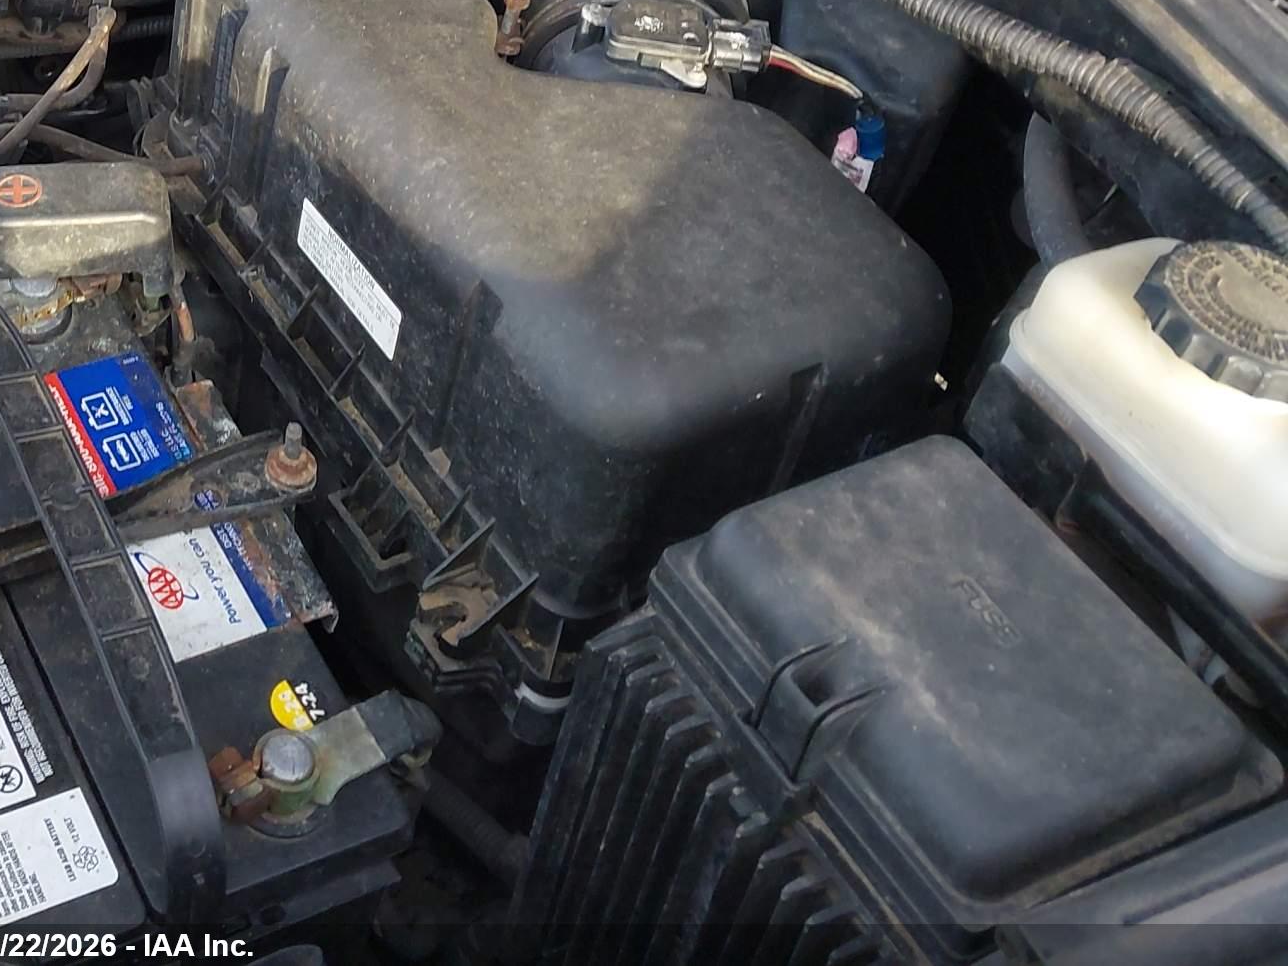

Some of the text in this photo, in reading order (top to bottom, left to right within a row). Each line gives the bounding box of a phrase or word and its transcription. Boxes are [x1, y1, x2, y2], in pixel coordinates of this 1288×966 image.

[185, 535, 205, 560] can
[199, 557, 223, 587] you
[211, 583, 242, 626] Power
[295, 681, 325, 720] 7-24
[62, 815, 76, 834] VOLT
[43, 816, 77, 882] LEAD ACID BATTERY
